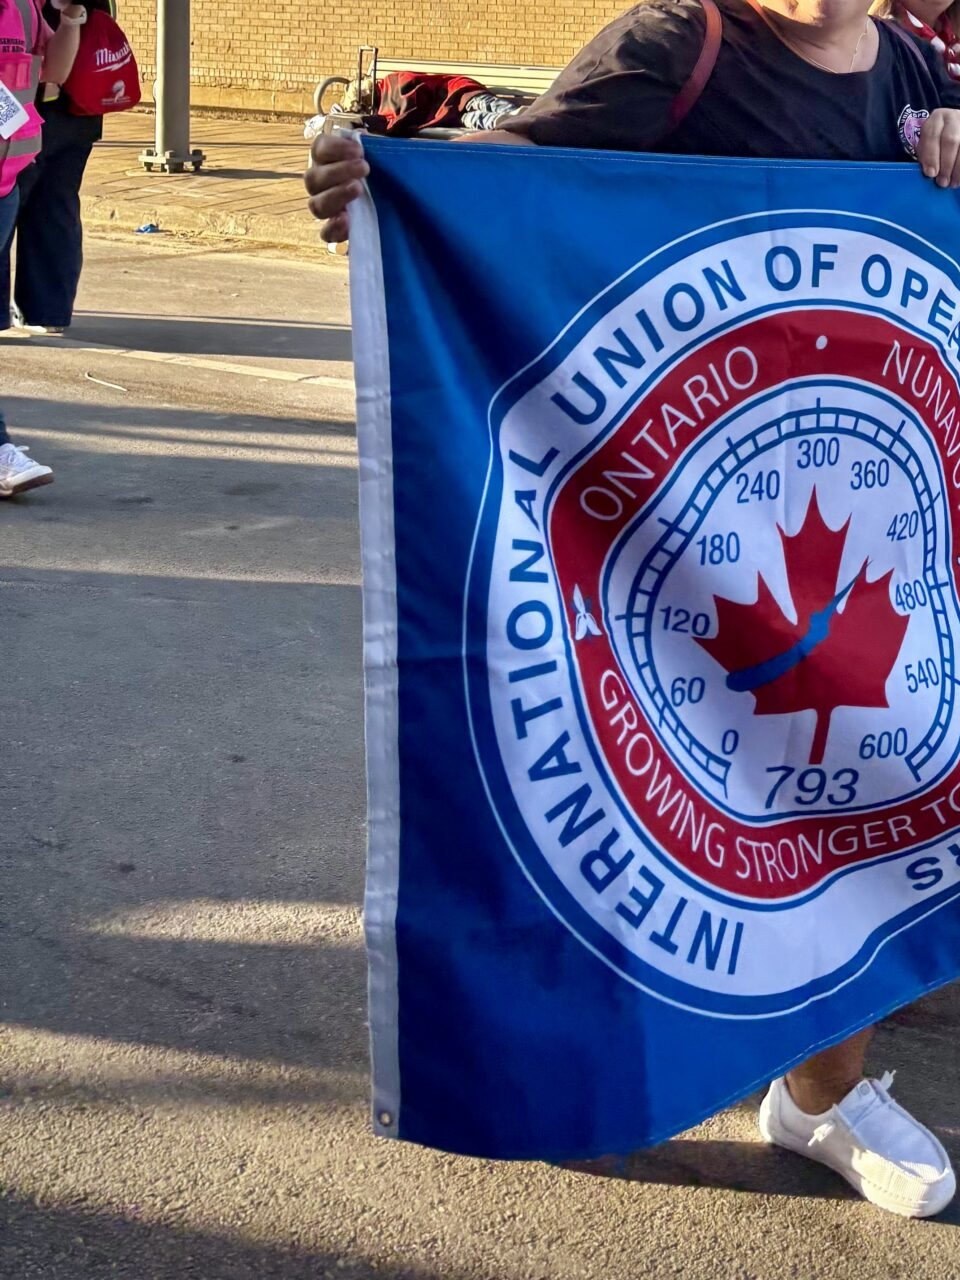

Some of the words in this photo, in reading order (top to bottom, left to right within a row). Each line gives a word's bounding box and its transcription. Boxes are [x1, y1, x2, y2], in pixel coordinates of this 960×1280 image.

[764, 243, 839, 292] OF
[550, 259, 747, 426] UNION
[579, 345, 759, 522] ONTARIO
[796, 437, 841, 470] 300
[735, 469, 781, 504] 240
[850, 458, 890, 491] 360
[886, 510, 919, 542] 420
[695, 531, 741, 566] 180
[894, 579, 928, 612] 480
[659, 605, 711, 638] 120
[671, 676, 706, 707] 60
[905, 657, 940, 694] 540
[506, 445, 744, 975] INTERNATIONAL
[721, 729, 739, 756] 0
[859, 727, 909, 761] 600
[599, 668, 728, 869] GROWING
[735, 814, 916, 885] STRONGER
[765, 765, 860, 809] 793
